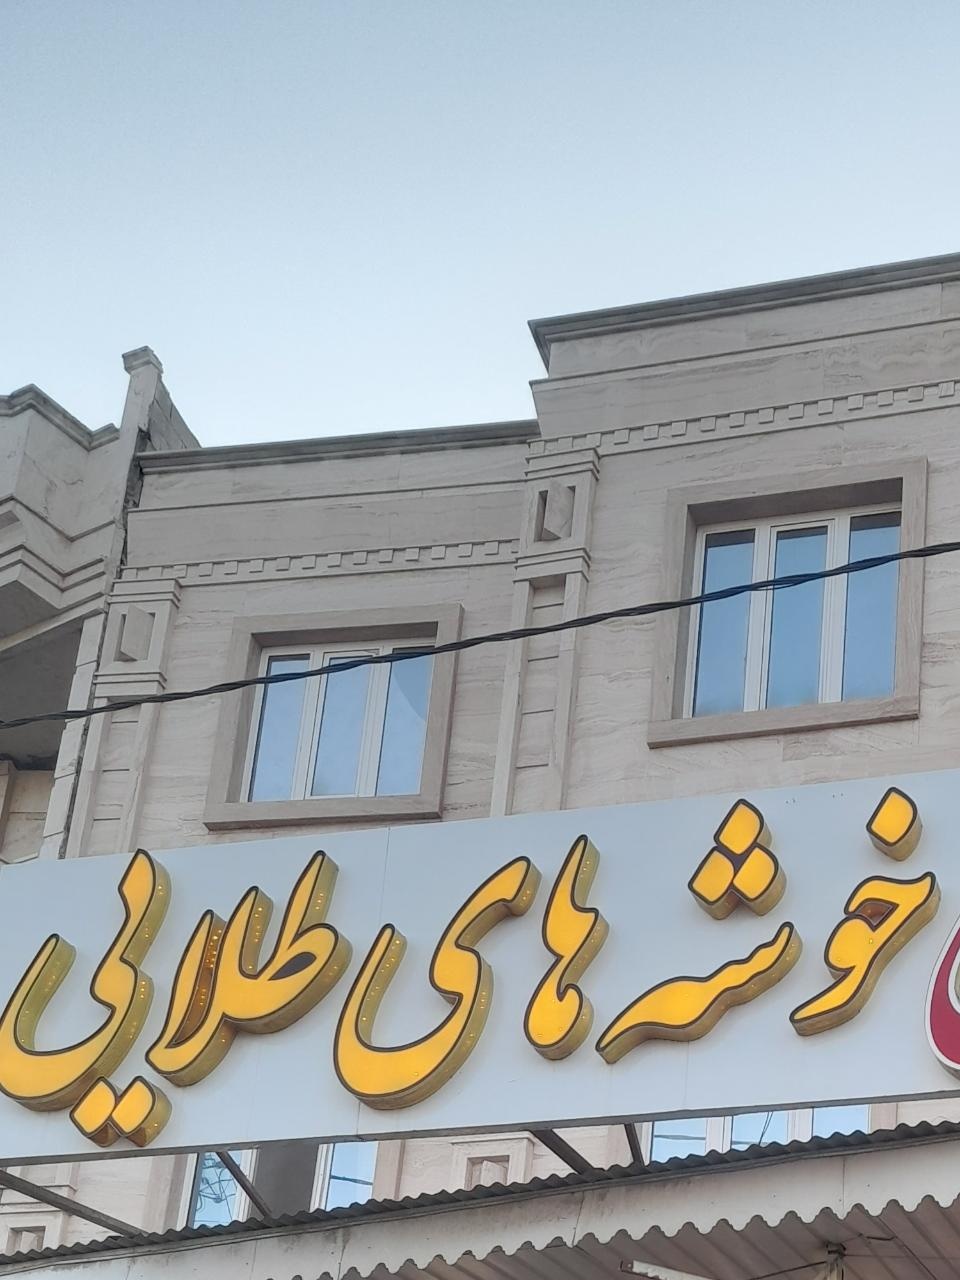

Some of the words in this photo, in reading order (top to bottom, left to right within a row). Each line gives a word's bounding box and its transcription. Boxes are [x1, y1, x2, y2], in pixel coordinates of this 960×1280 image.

[0, 849, 351, 1148] طلایی
[334, 834, 608, 1110] های
[595, 786, 943, 1064] خوشه
